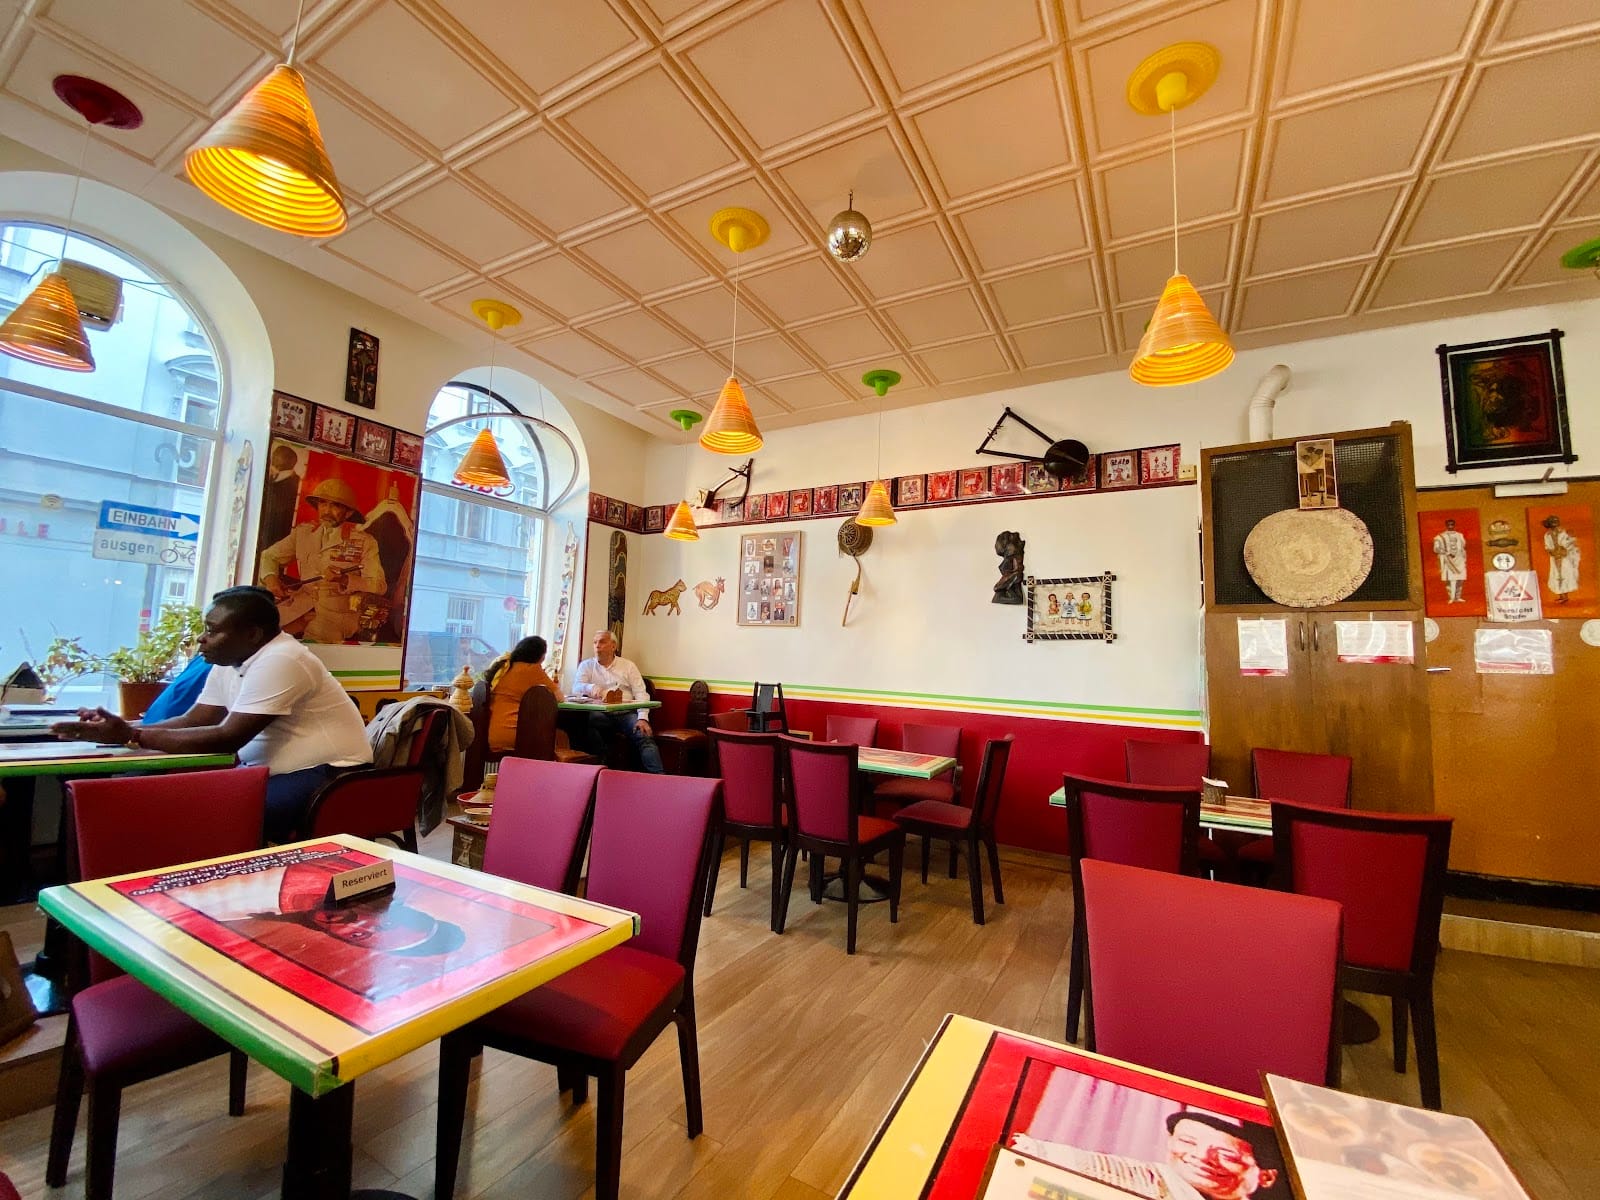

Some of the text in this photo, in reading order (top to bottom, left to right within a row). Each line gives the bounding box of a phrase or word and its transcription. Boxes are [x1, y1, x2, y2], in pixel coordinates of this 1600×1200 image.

[113, 510, 177, 531] EINBAHN
[101, 539, 160, 556] ausgen.
[196, 873, 225, 884] April
[342, 869, 388, 888] Reserviert
